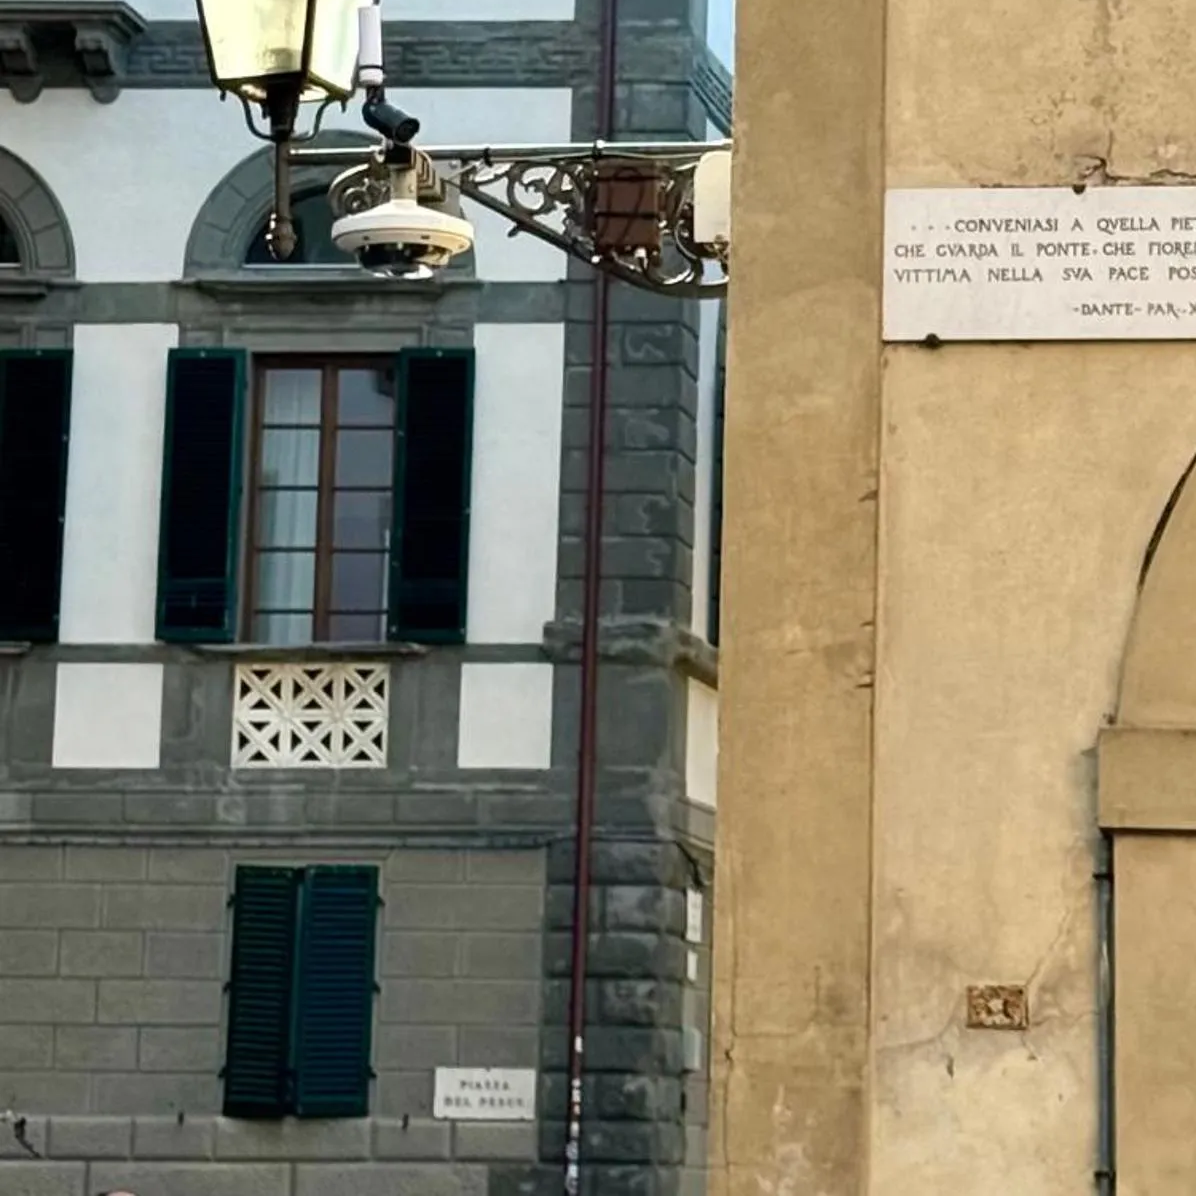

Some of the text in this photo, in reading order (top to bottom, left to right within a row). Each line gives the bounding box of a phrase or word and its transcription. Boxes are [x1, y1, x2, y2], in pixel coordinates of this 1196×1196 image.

[1071, 218, 1084, 232] A
[1097, 217, 1161, 235] QVELLA
[894, 244, 926, 258] CHE
[1011, 244, 1024, 257] IL
[1102, 242, 1136, 256] CHE
[894, 268, 972, 283] VITTIMA
[988, 268, 1043, 282] NELLA
[1062, 268, 1093, 281] SVA
[1109, 266, 1150, 281] PACE
